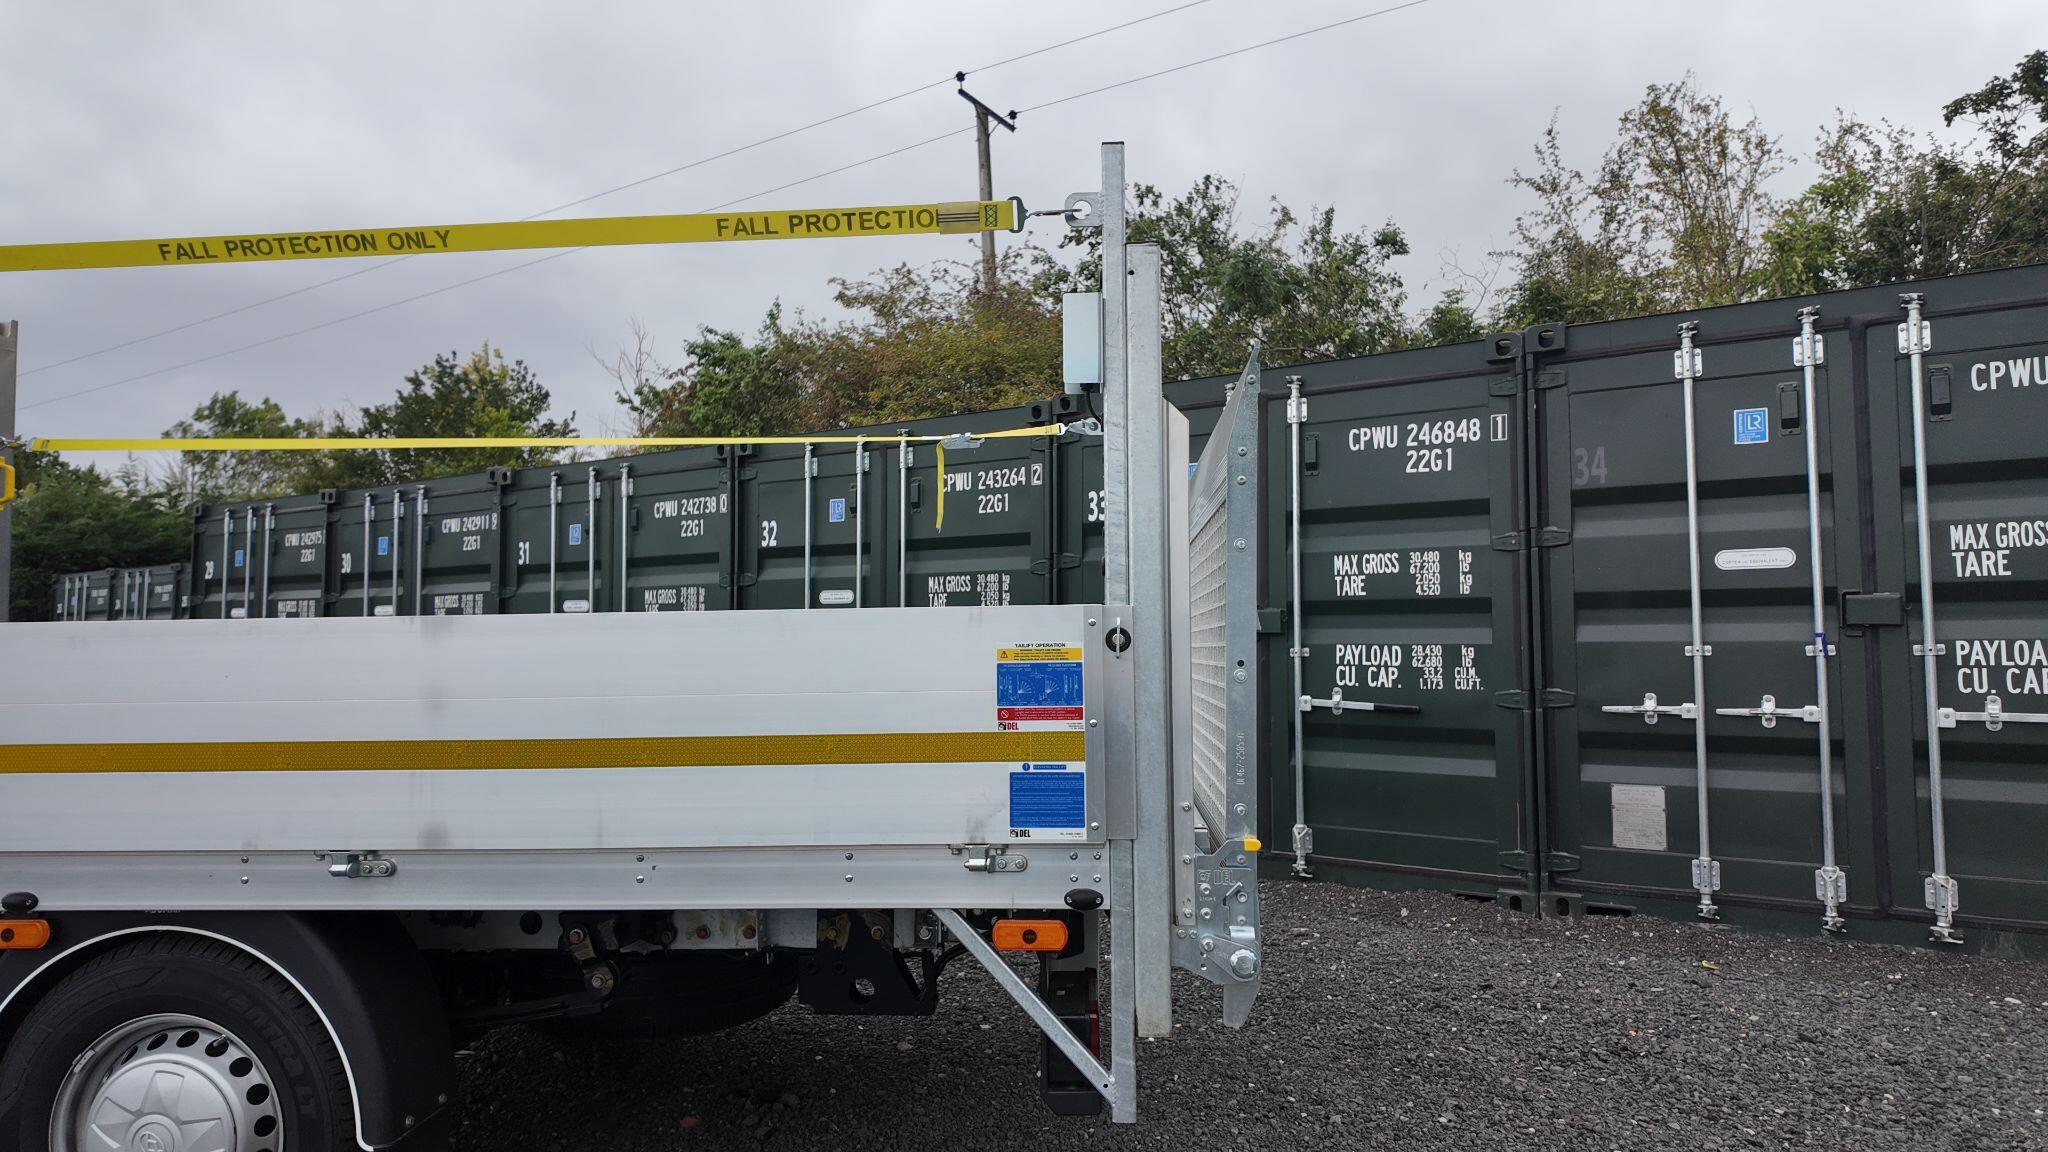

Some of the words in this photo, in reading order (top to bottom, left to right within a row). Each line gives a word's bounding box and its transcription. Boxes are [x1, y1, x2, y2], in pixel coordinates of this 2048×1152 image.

[716, 218, 778, 237] FALL
[788, 208, 940, 234] PROTECTIO
[157, 241, 218, 261] FALL
[224, 233, 377, 258] PROTECTION
[387, 230, 450, 251] ONLY
[1971, 356, 2048, 391] CPWU
[1748, 415, 1761, 430] LR
[1349, 424, 1398, 451] CPWU
[1406, 418, 1480, 447] 246848
[1406, 448, 1452, 473] 22G1
[1574, 446, 1608, 485] 34
[978, 467, 1026, 490] 243264
[1032, 464, 1041, 485] 2
[654, 500, 677, 519] CPWU
[681, 496, 716, 515] 242738
[978, 493, 1008, 513] 22G1
[442, 518, 460, 533] CPWU
[463, 514, 489, 531] 242911
[681, 519, 703, 537] 22G1
[761, 520, 777, 547] 32
[463, 535, 480, 551] 22G1
[1950, 523, 1990, 550] MAX
[1996, 521, 2048, 548] GROS
[341, 553, 351, 573] 30
[518, 541, 530, 565] 31
[1334, 555, 1358, 575] MAX
[1363, 553, 1399, 574] GROSS
[1409, 551, 1439, 564] 30.480
[1459, 550, 1471, 563] kg
[1952, 550, 2011, 577] TARE
[205, 561, 214, 580] 29
[1409, 563, 1440, 574] 67.200
[1460, 562, 1470, 572] lb
[928, 576, 944, 593] MAX
[945, 575, 971, 592] GROSS
[977, 574, 999, 583] 30.480
[1002, 573, 1010, 583] kg
[1335, 575, 1366, 596] TARE
[1415, 574, 1440, 585] 2.050
[1459, 573, 1472, 585] kg
[1416, 584, 1441, 595] 4.520
[1460, 584, 1470, 594] lb
[658, 589, 676, 604] GROSS
[1336, 644, 1401, 666] PAYLOAD
[1412, 645, 1442, 656] 28.430
[1461, 645, 1474, 658] kg
[1412, 656, 1443, 668] 62.680
[1462, 656, 1472, 667] lb
[1336, 666, 1359, 687] CU.
[1368, 667, 1402, 688] CAP.
[1423, 667, 1443, 679] 33.2
[1455, 667, 1478, 679] CU.M.
[1420, 678, 1443, 690] 1.173
[1455, 678, 1484, 690] CU.FT.
[1957, 668, 1996, 694] CU.
